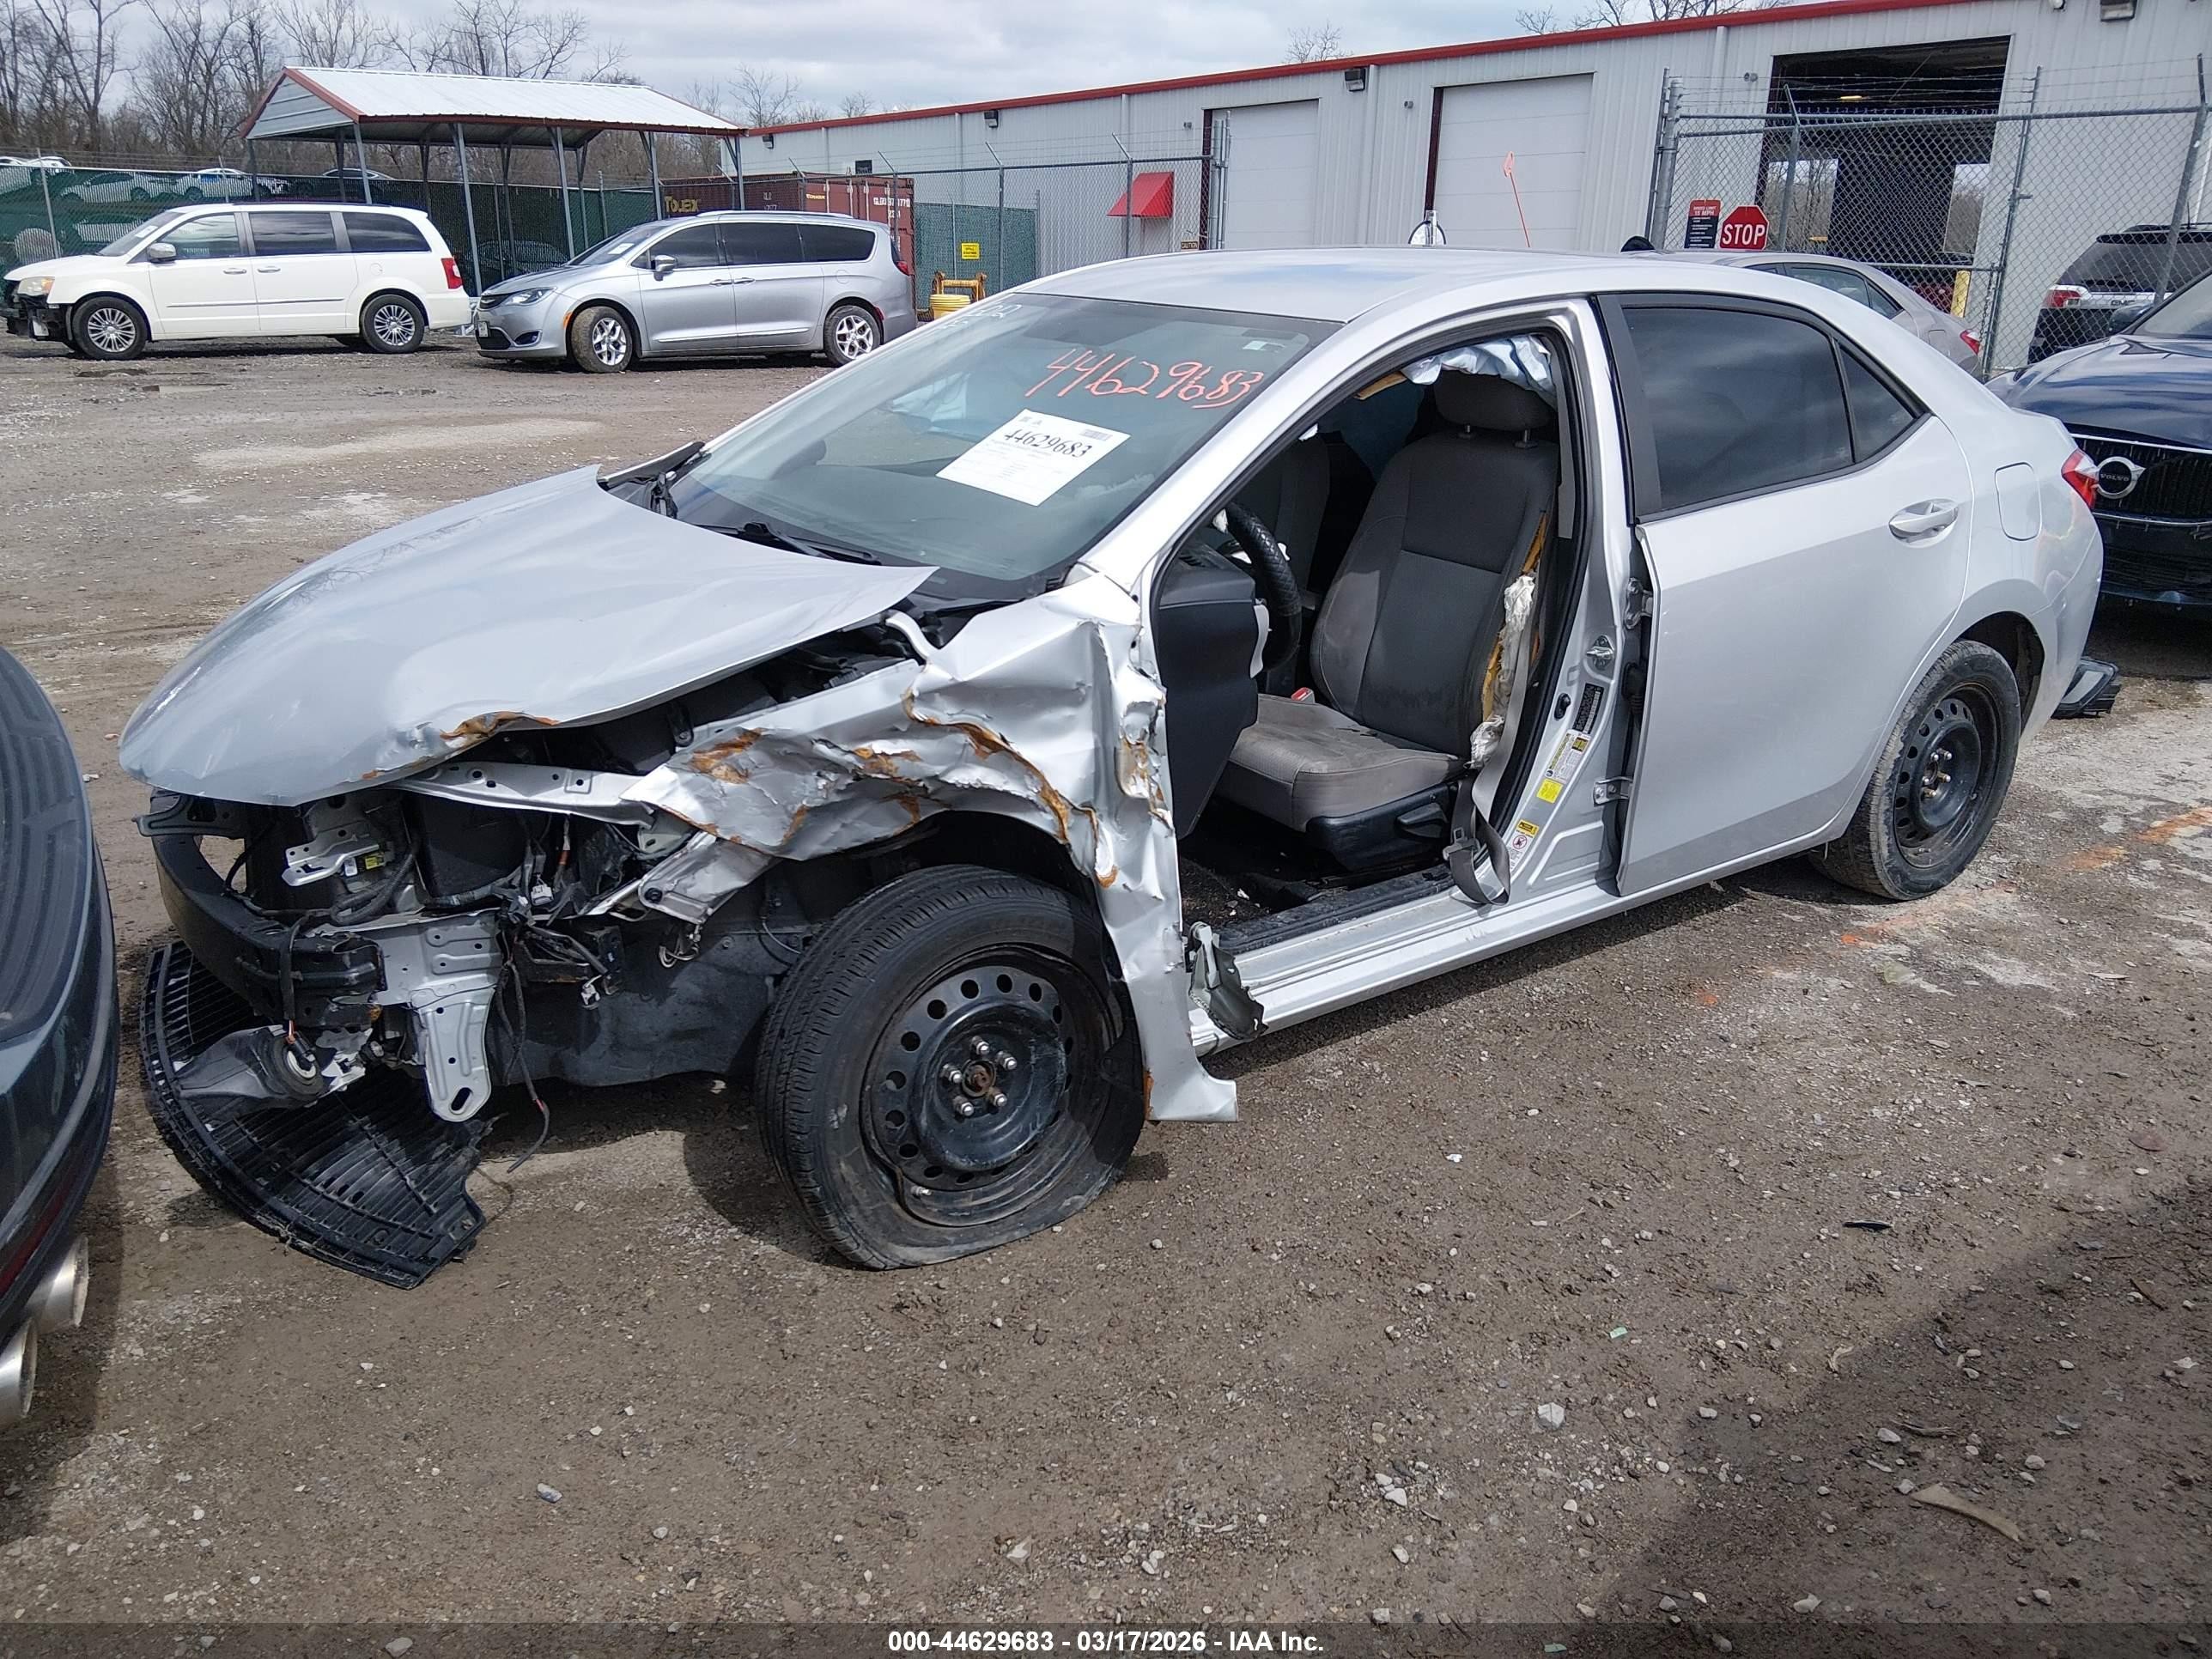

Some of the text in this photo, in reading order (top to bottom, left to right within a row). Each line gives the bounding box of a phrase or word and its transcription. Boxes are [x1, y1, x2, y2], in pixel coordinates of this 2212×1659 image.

[1722, 223, 1765, 246] STOP
[1024, 348, 1265, 409] 44629683
[1003, 429, 1093, 458] 44629683
[2100, 473, 2130, 482] VOLVO
